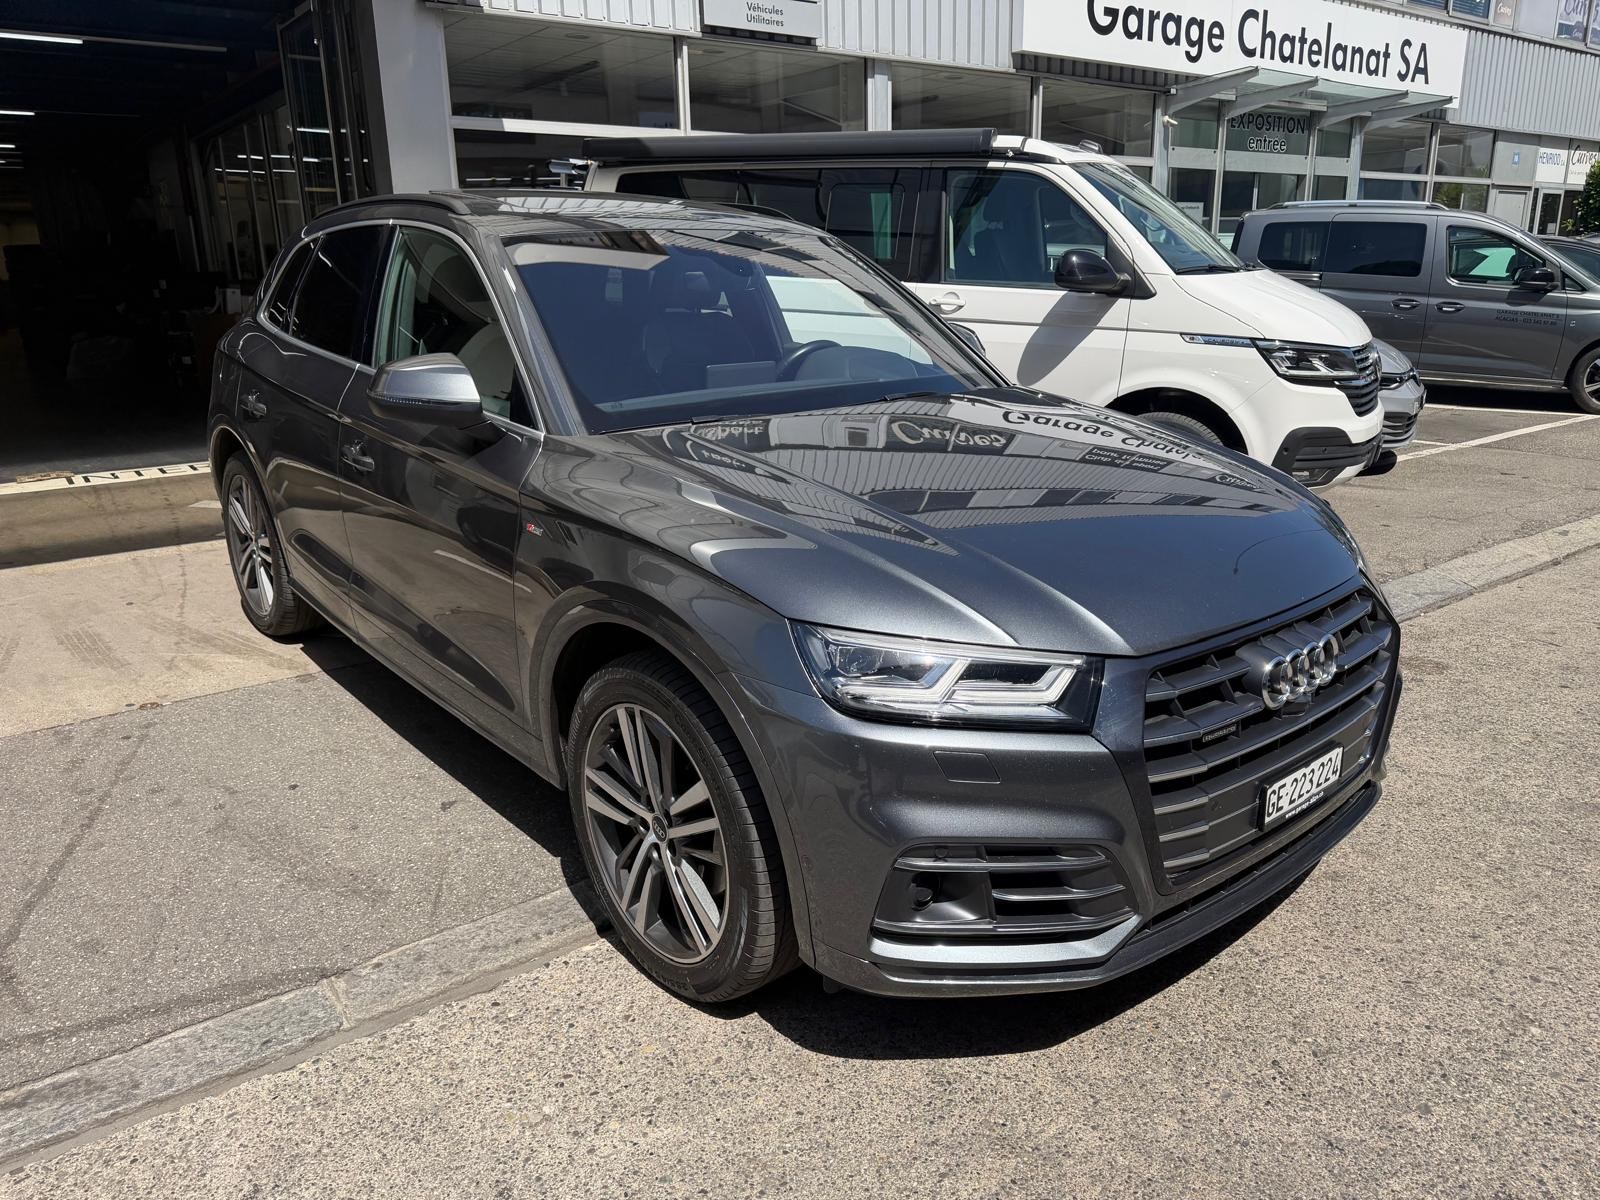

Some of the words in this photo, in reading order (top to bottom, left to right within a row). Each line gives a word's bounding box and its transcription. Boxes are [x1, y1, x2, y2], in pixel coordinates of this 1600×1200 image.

[746, 1, 784, 16] Véhicules
[746, 13, 784, 27] Utilitaires
[1086, 0, 1225, 64] Garage
[1237, 8, 1391, 78] Chatelanat
[1398, 37, 1430, 85] SA
[1230, 112, 1306, 135] EXPOSITION
[1248, 135, 1287, 152] entrée
